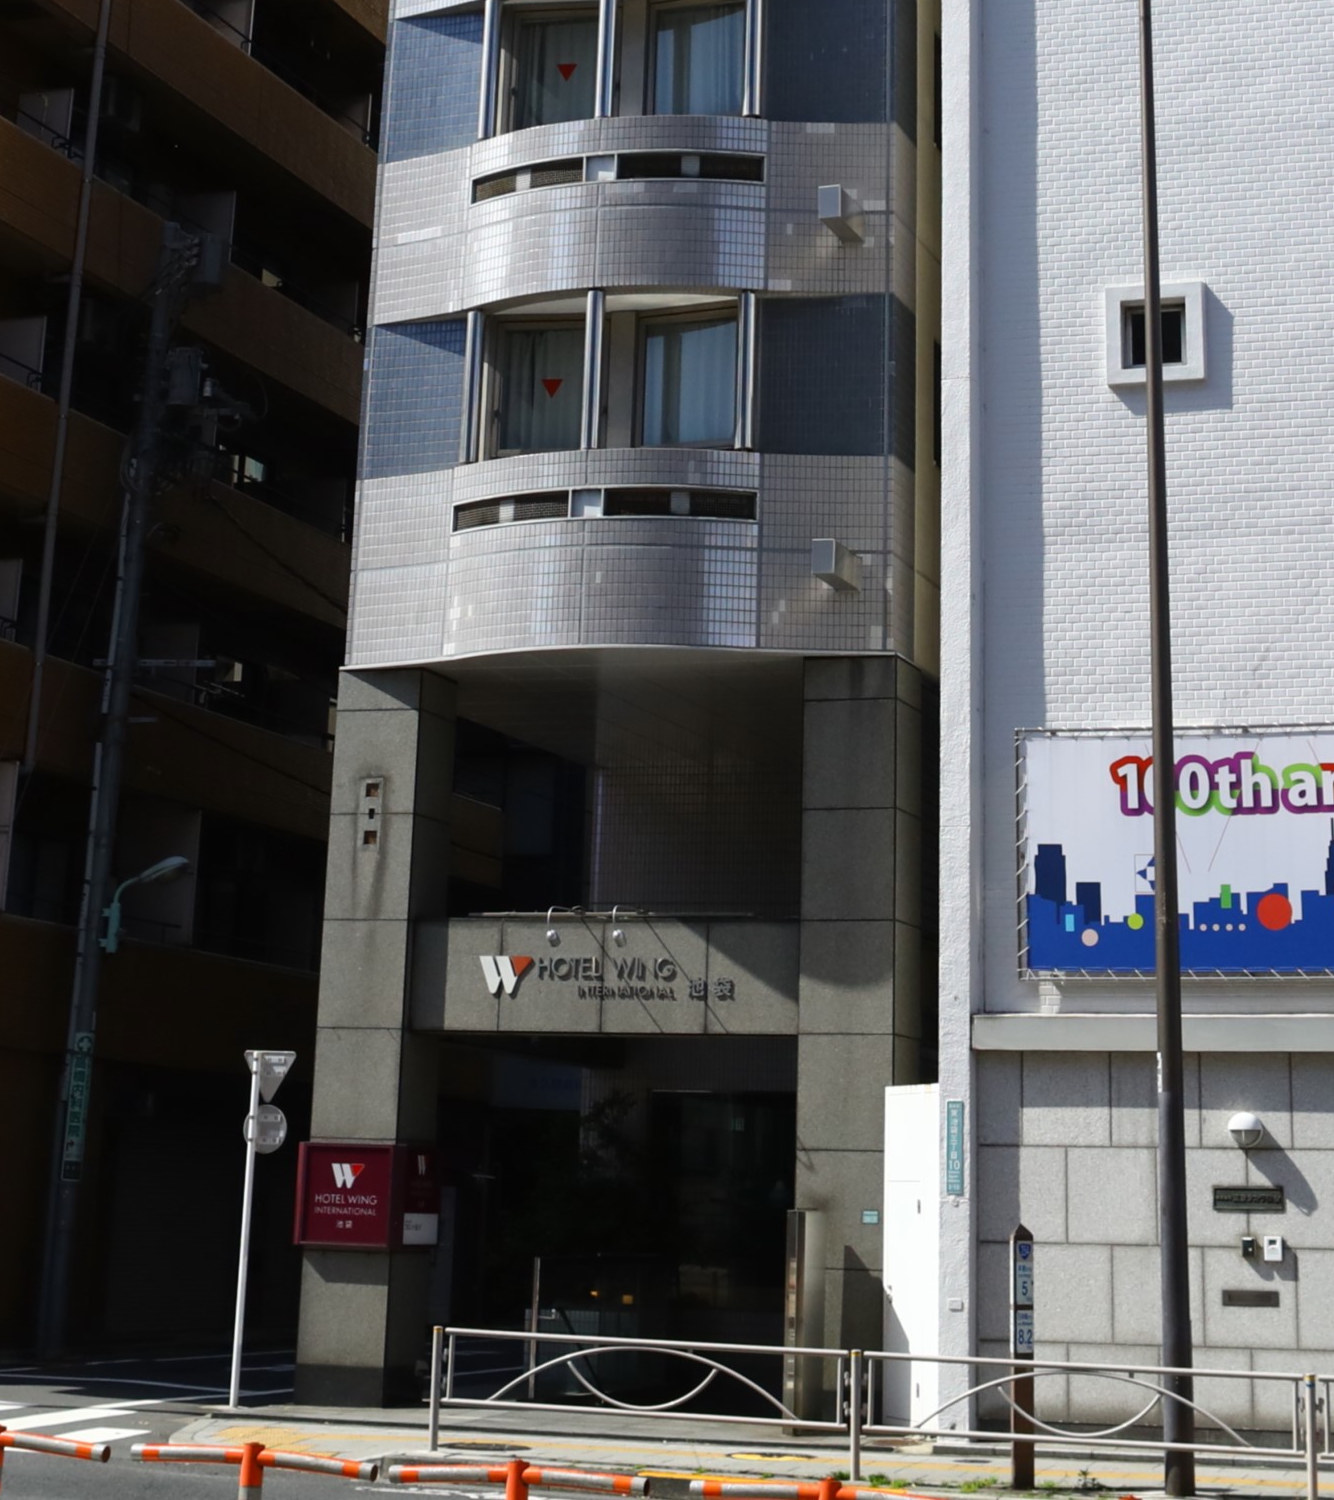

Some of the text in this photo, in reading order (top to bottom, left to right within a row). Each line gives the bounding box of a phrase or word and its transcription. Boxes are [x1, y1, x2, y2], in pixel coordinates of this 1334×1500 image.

[538, 956, 676, 981] HOTEL WING
[577, 985, 676, 1000] INTERNATIONAL
[688, 977, 734, 999] 池袋
[949, 1160, 960, 1170] 10
[315, 1193, 377, 1206] HOTEL WING
[314, 1205, 377, 1217] INTERNATIONAL
[1018, 1329, 1033, 1345] 8.2
